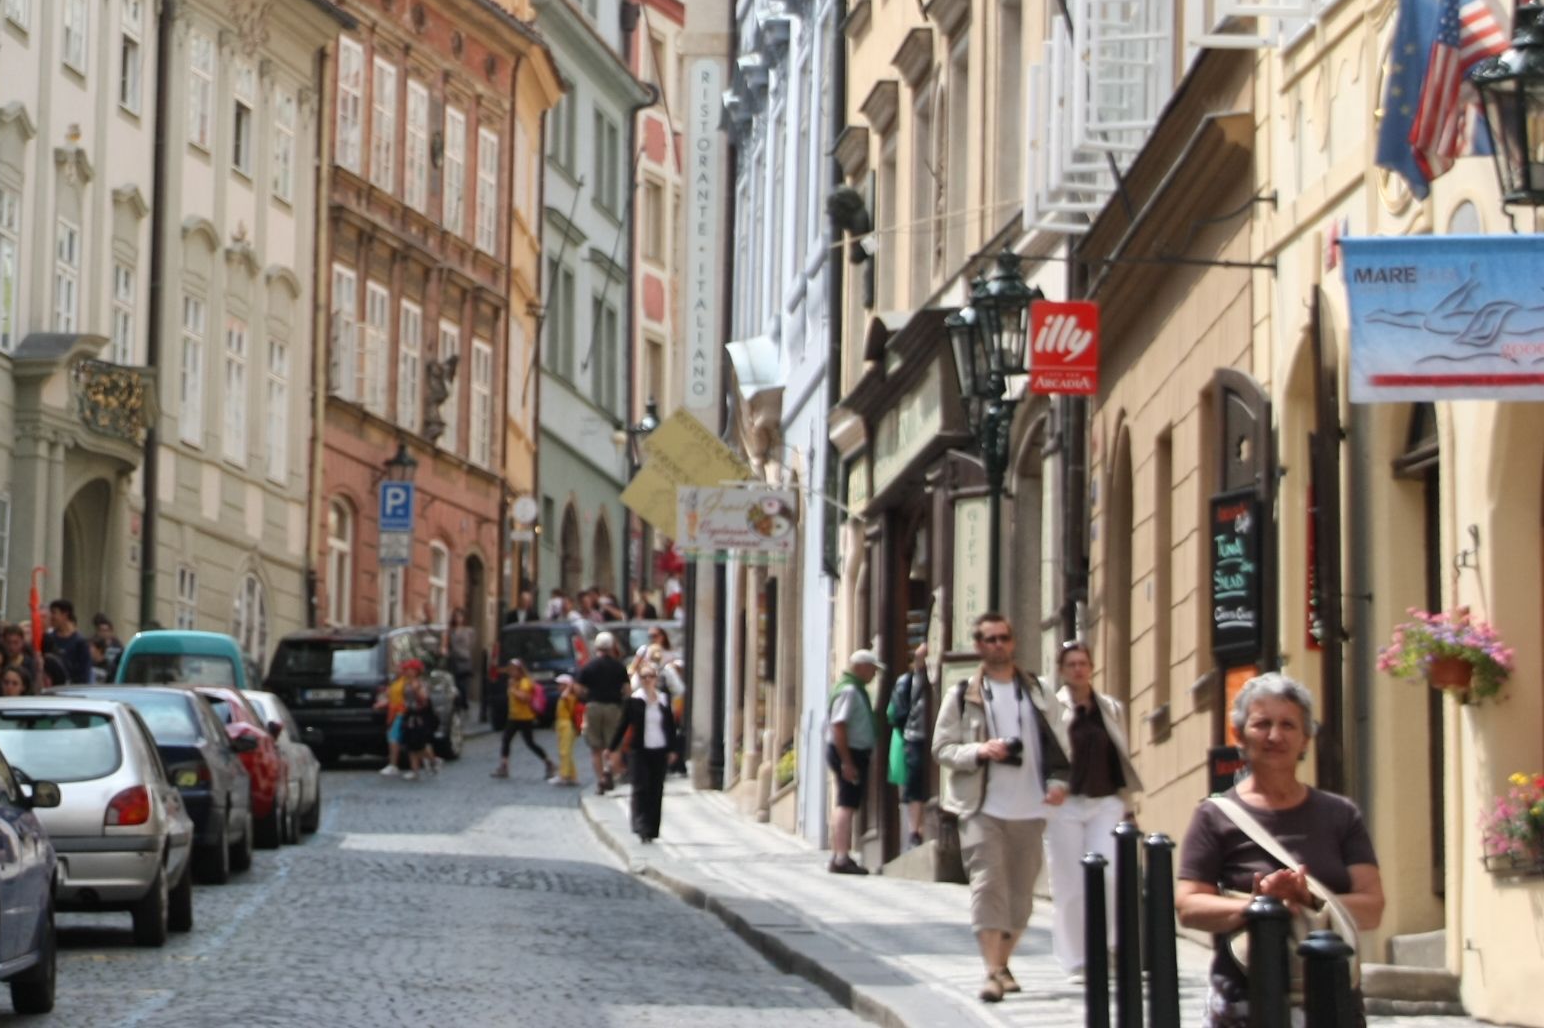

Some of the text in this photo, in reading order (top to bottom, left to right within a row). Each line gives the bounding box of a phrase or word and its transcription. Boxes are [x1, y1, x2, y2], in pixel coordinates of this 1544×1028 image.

[693, 71, 711, 397] RISTORANTE ITALIANO
[1353, 266, 1418, 284] MARE
[1034, 313, 1093, 363] illy
